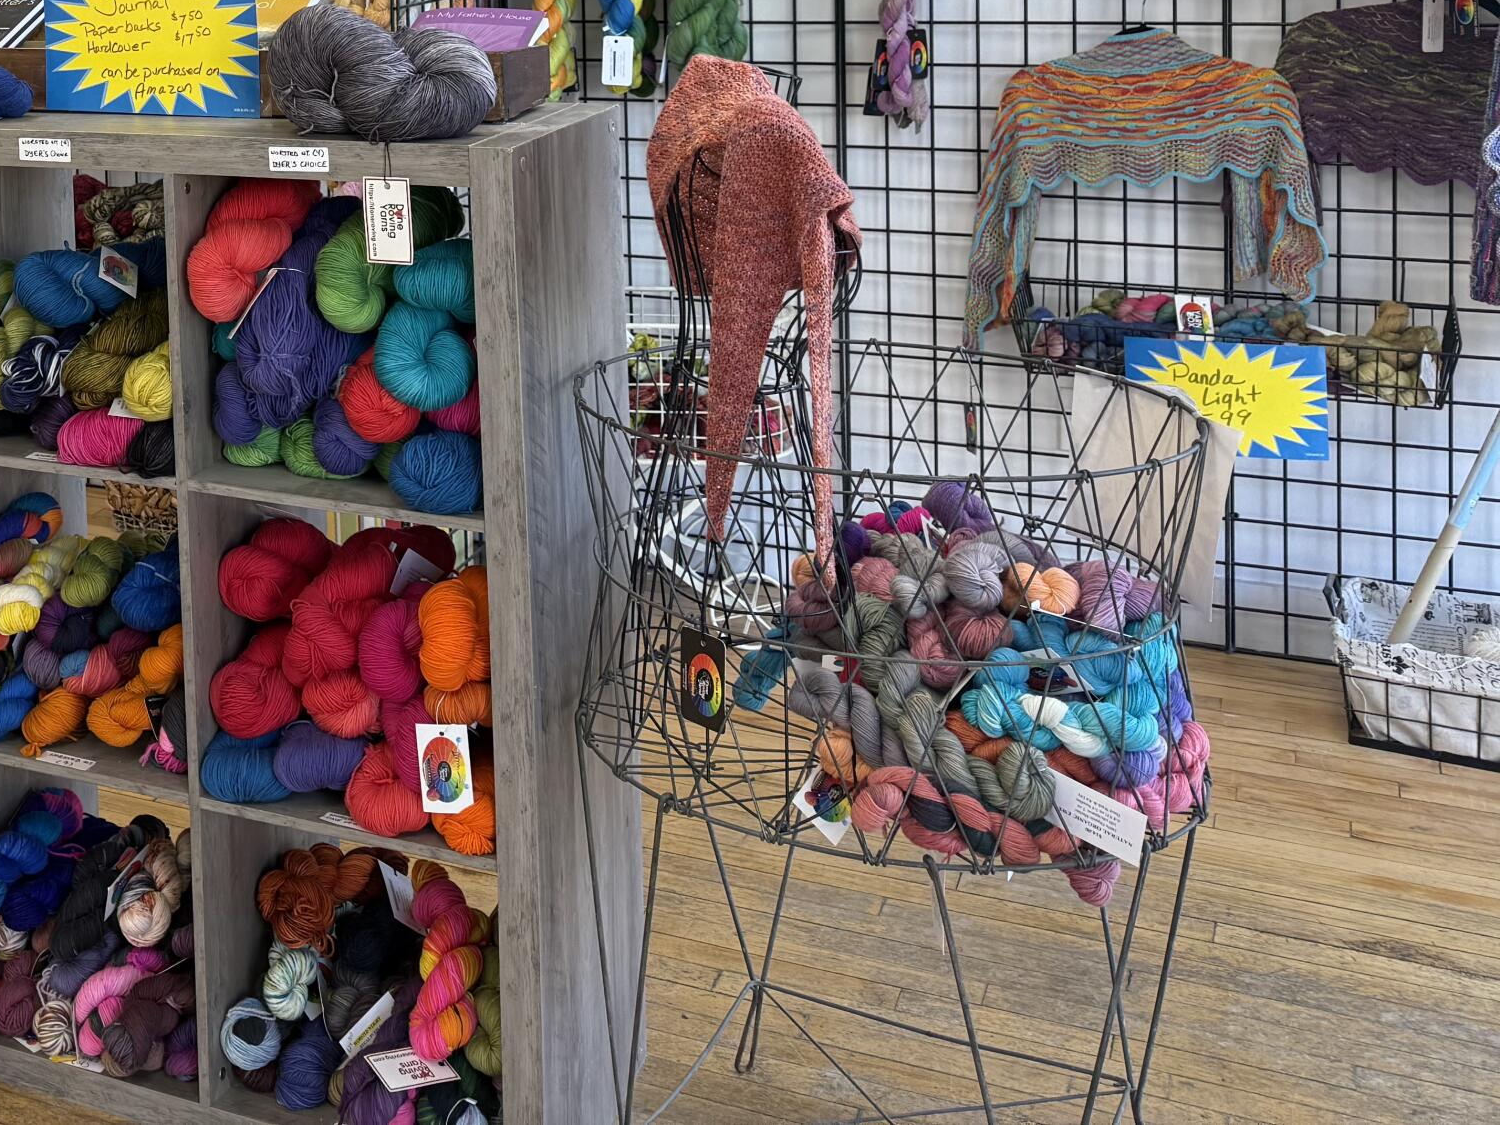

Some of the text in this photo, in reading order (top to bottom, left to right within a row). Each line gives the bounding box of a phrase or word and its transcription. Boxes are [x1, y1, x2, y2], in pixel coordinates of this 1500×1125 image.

[142, 61, 203, 82] purchased
[206, 67, 221, 77] on
[134, 83, 193, 101] Amazon
[379, 204, 388, 232] Yarns
[387, 203, 396, 239] Roving
[395, 203, 405, 231] Done
[1166, 362, 1247, 387] Panda
[1202, 385, 1263, 411] Light
